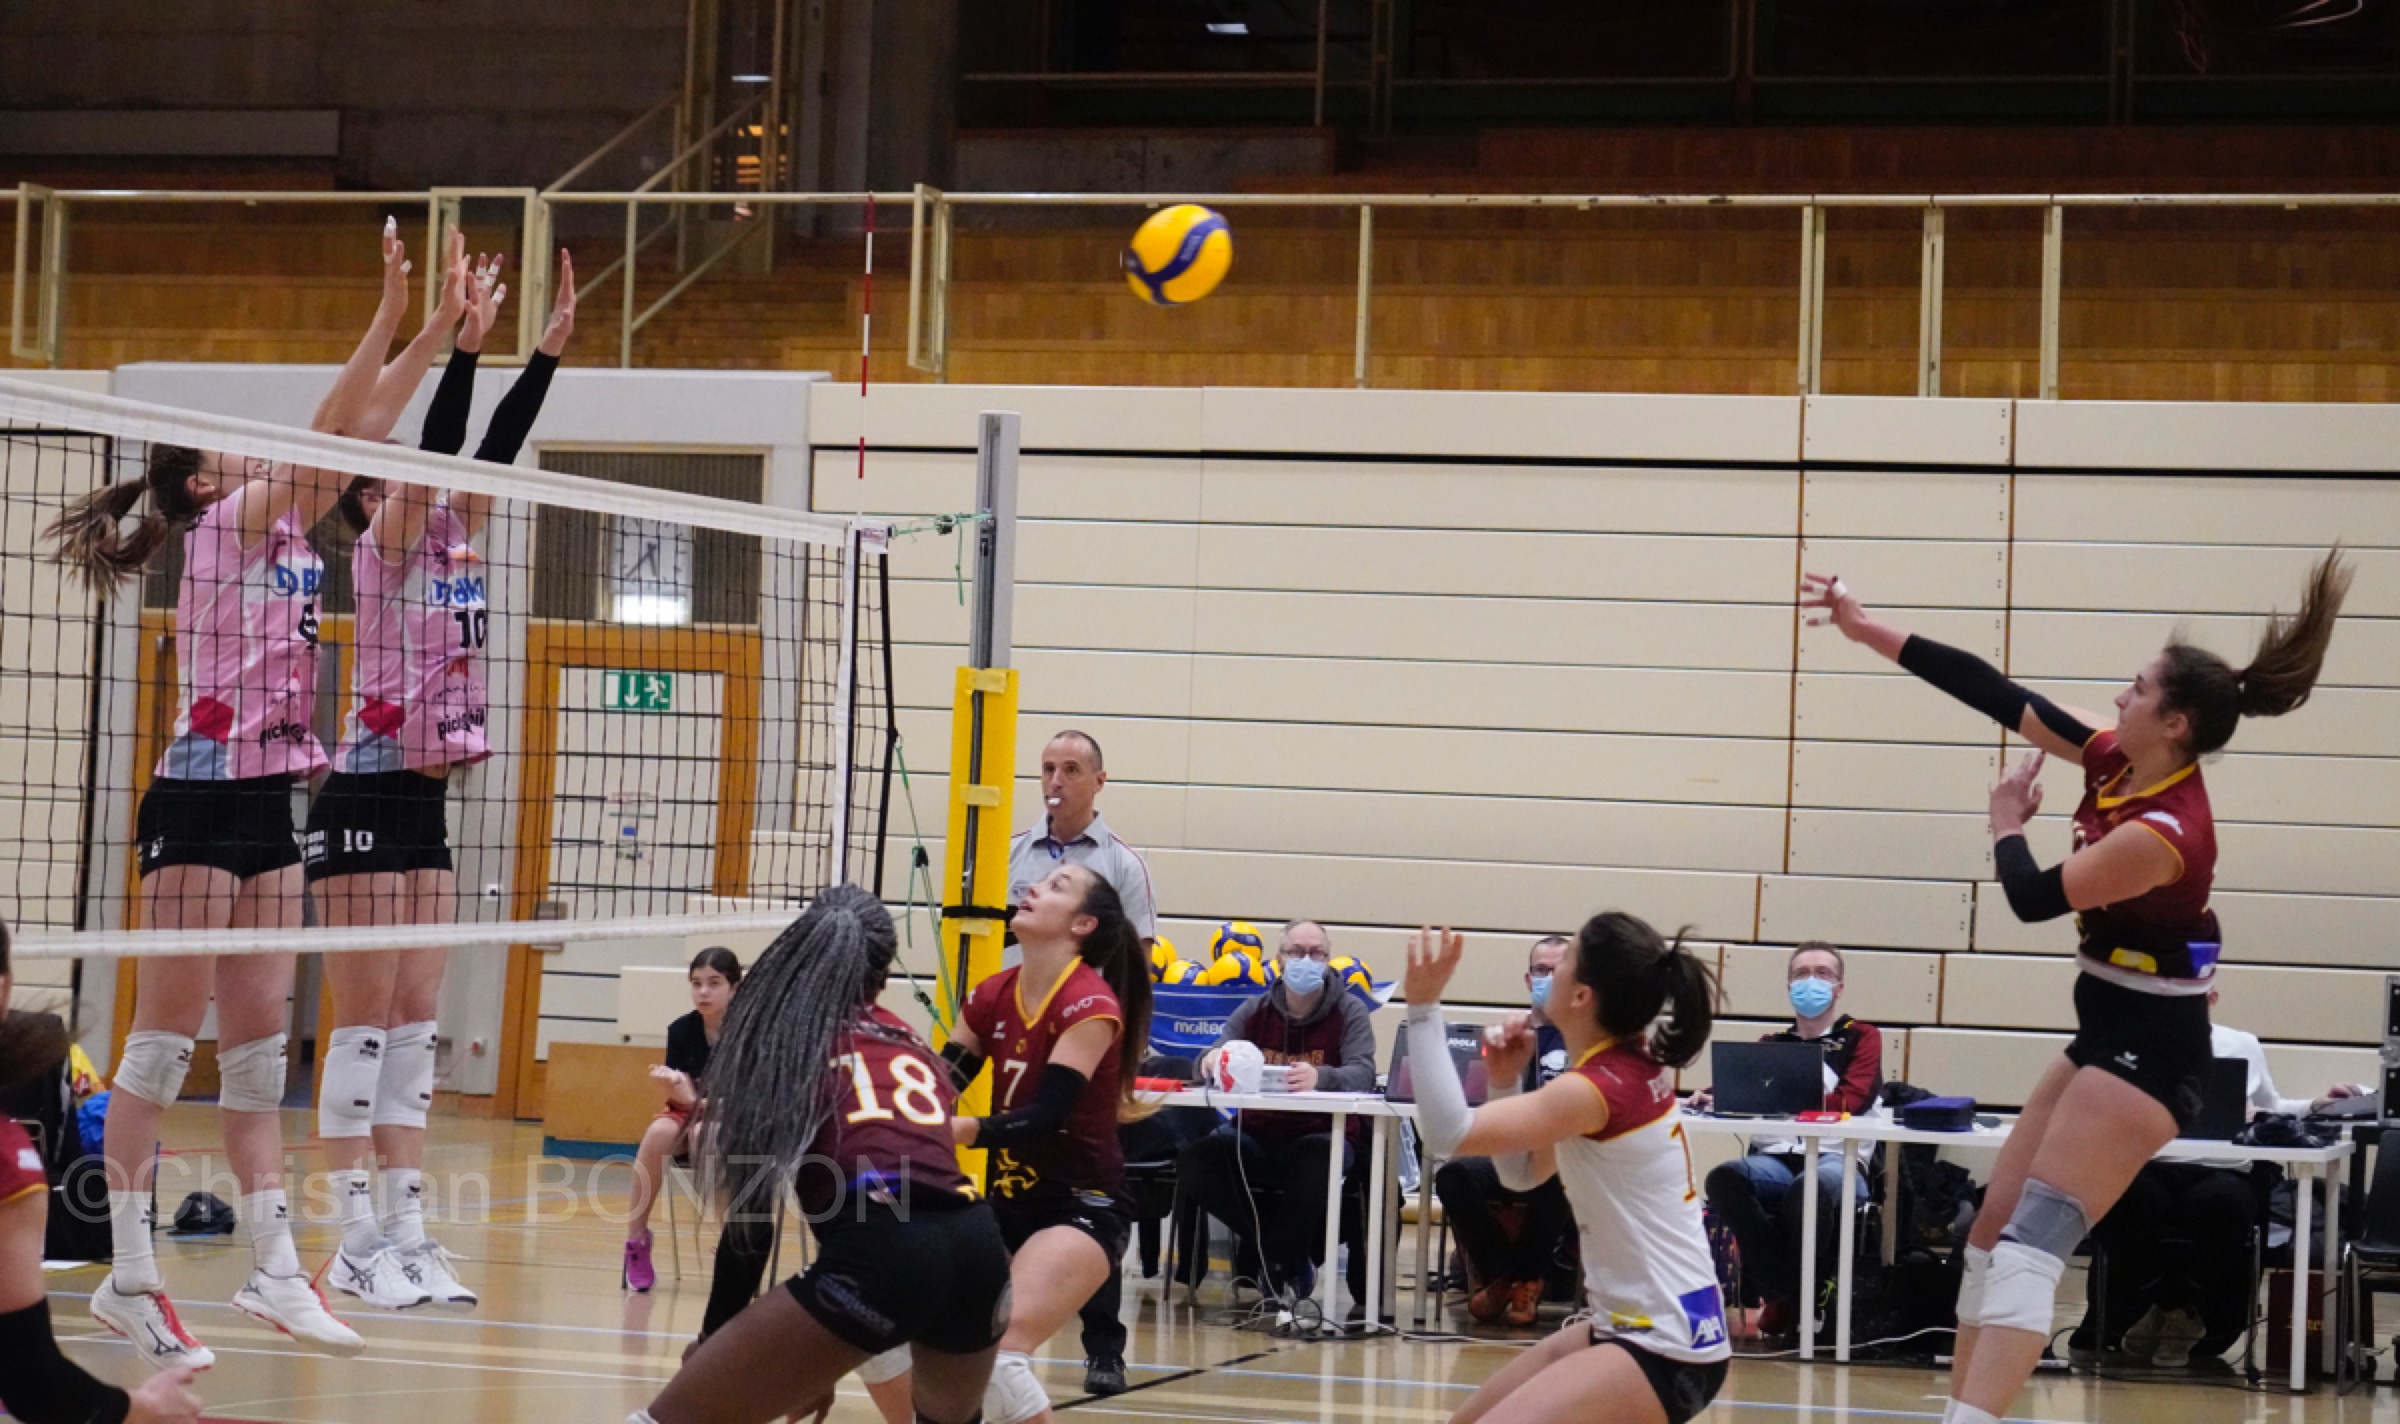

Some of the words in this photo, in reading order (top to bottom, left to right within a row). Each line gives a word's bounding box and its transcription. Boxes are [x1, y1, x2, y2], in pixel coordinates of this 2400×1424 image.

[453, 609, 488, 649] 10
[343, 827, 374, 852] 10
[828, 1051, 945, 1125] 18
[1003, 1059, 1029, 1108] 7
